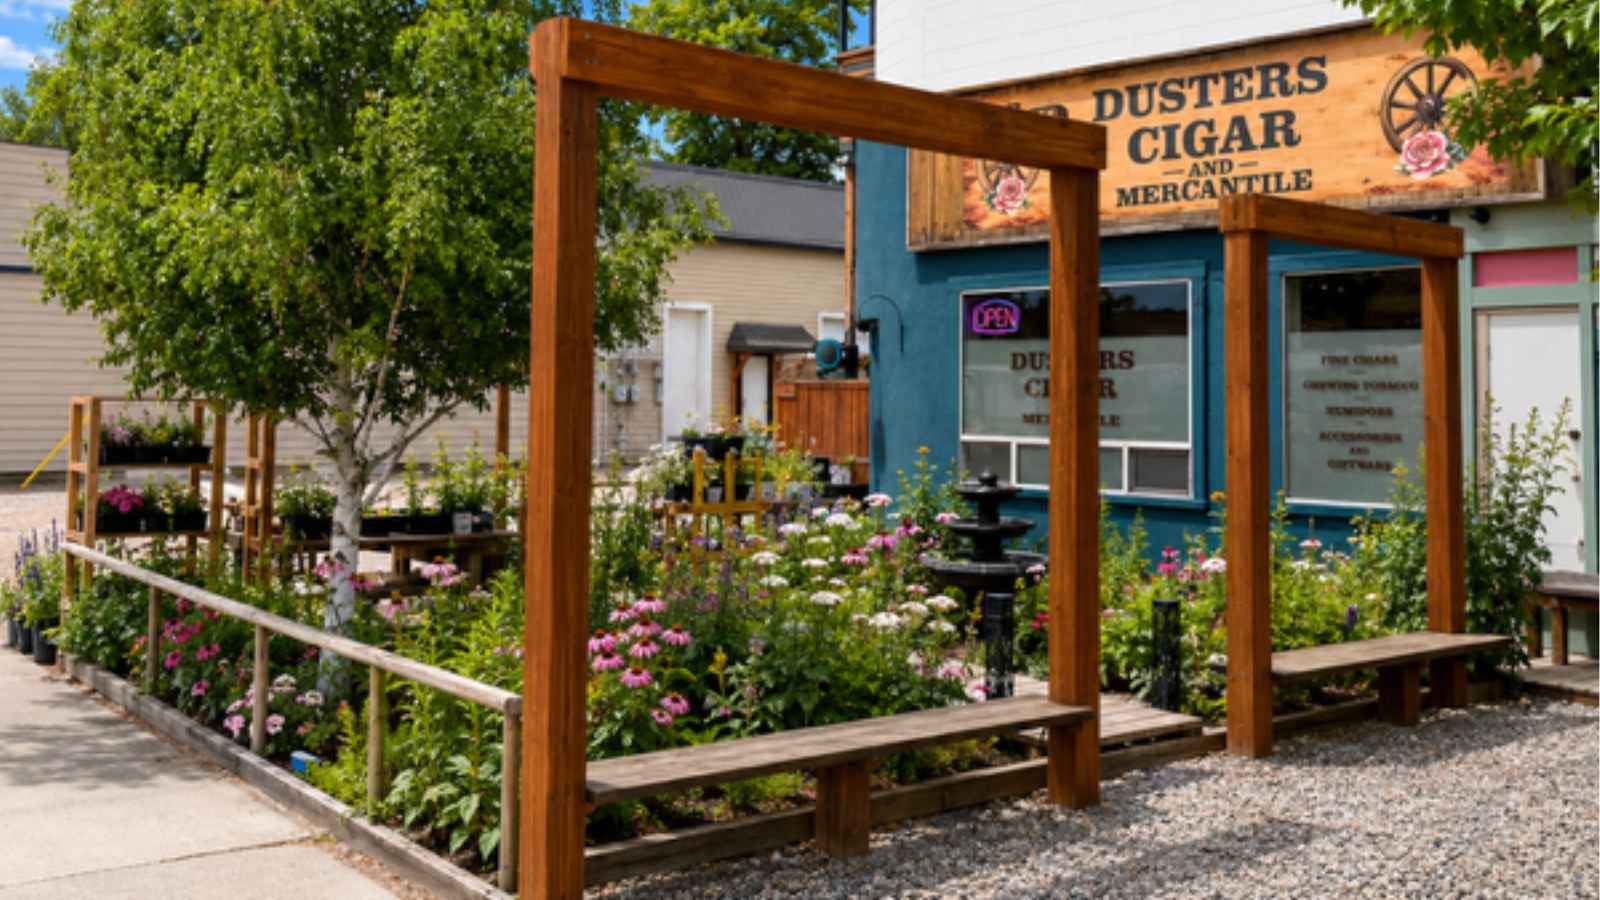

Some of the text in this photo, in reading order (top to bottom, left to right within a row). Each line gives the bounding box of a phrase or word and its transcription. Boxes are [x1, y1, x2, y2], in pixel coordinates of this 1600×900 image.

[1092, 55, 1328, 122] DUSTERS
[1127, 109, 1301, 164] CIGAR
[1188, 158, 1233, 178] AND
[1116, 168, 1313, 208] MERCANTILE
[976, 306, 1016, 327] OPEN
[1011, 350, 1135, 370] DURS
[1321, 355, 1398, 366] FINE CIGARS
[1023, 377, 1117, 399] CIR
[1363, 380, 1419, 391] TOBACCO
